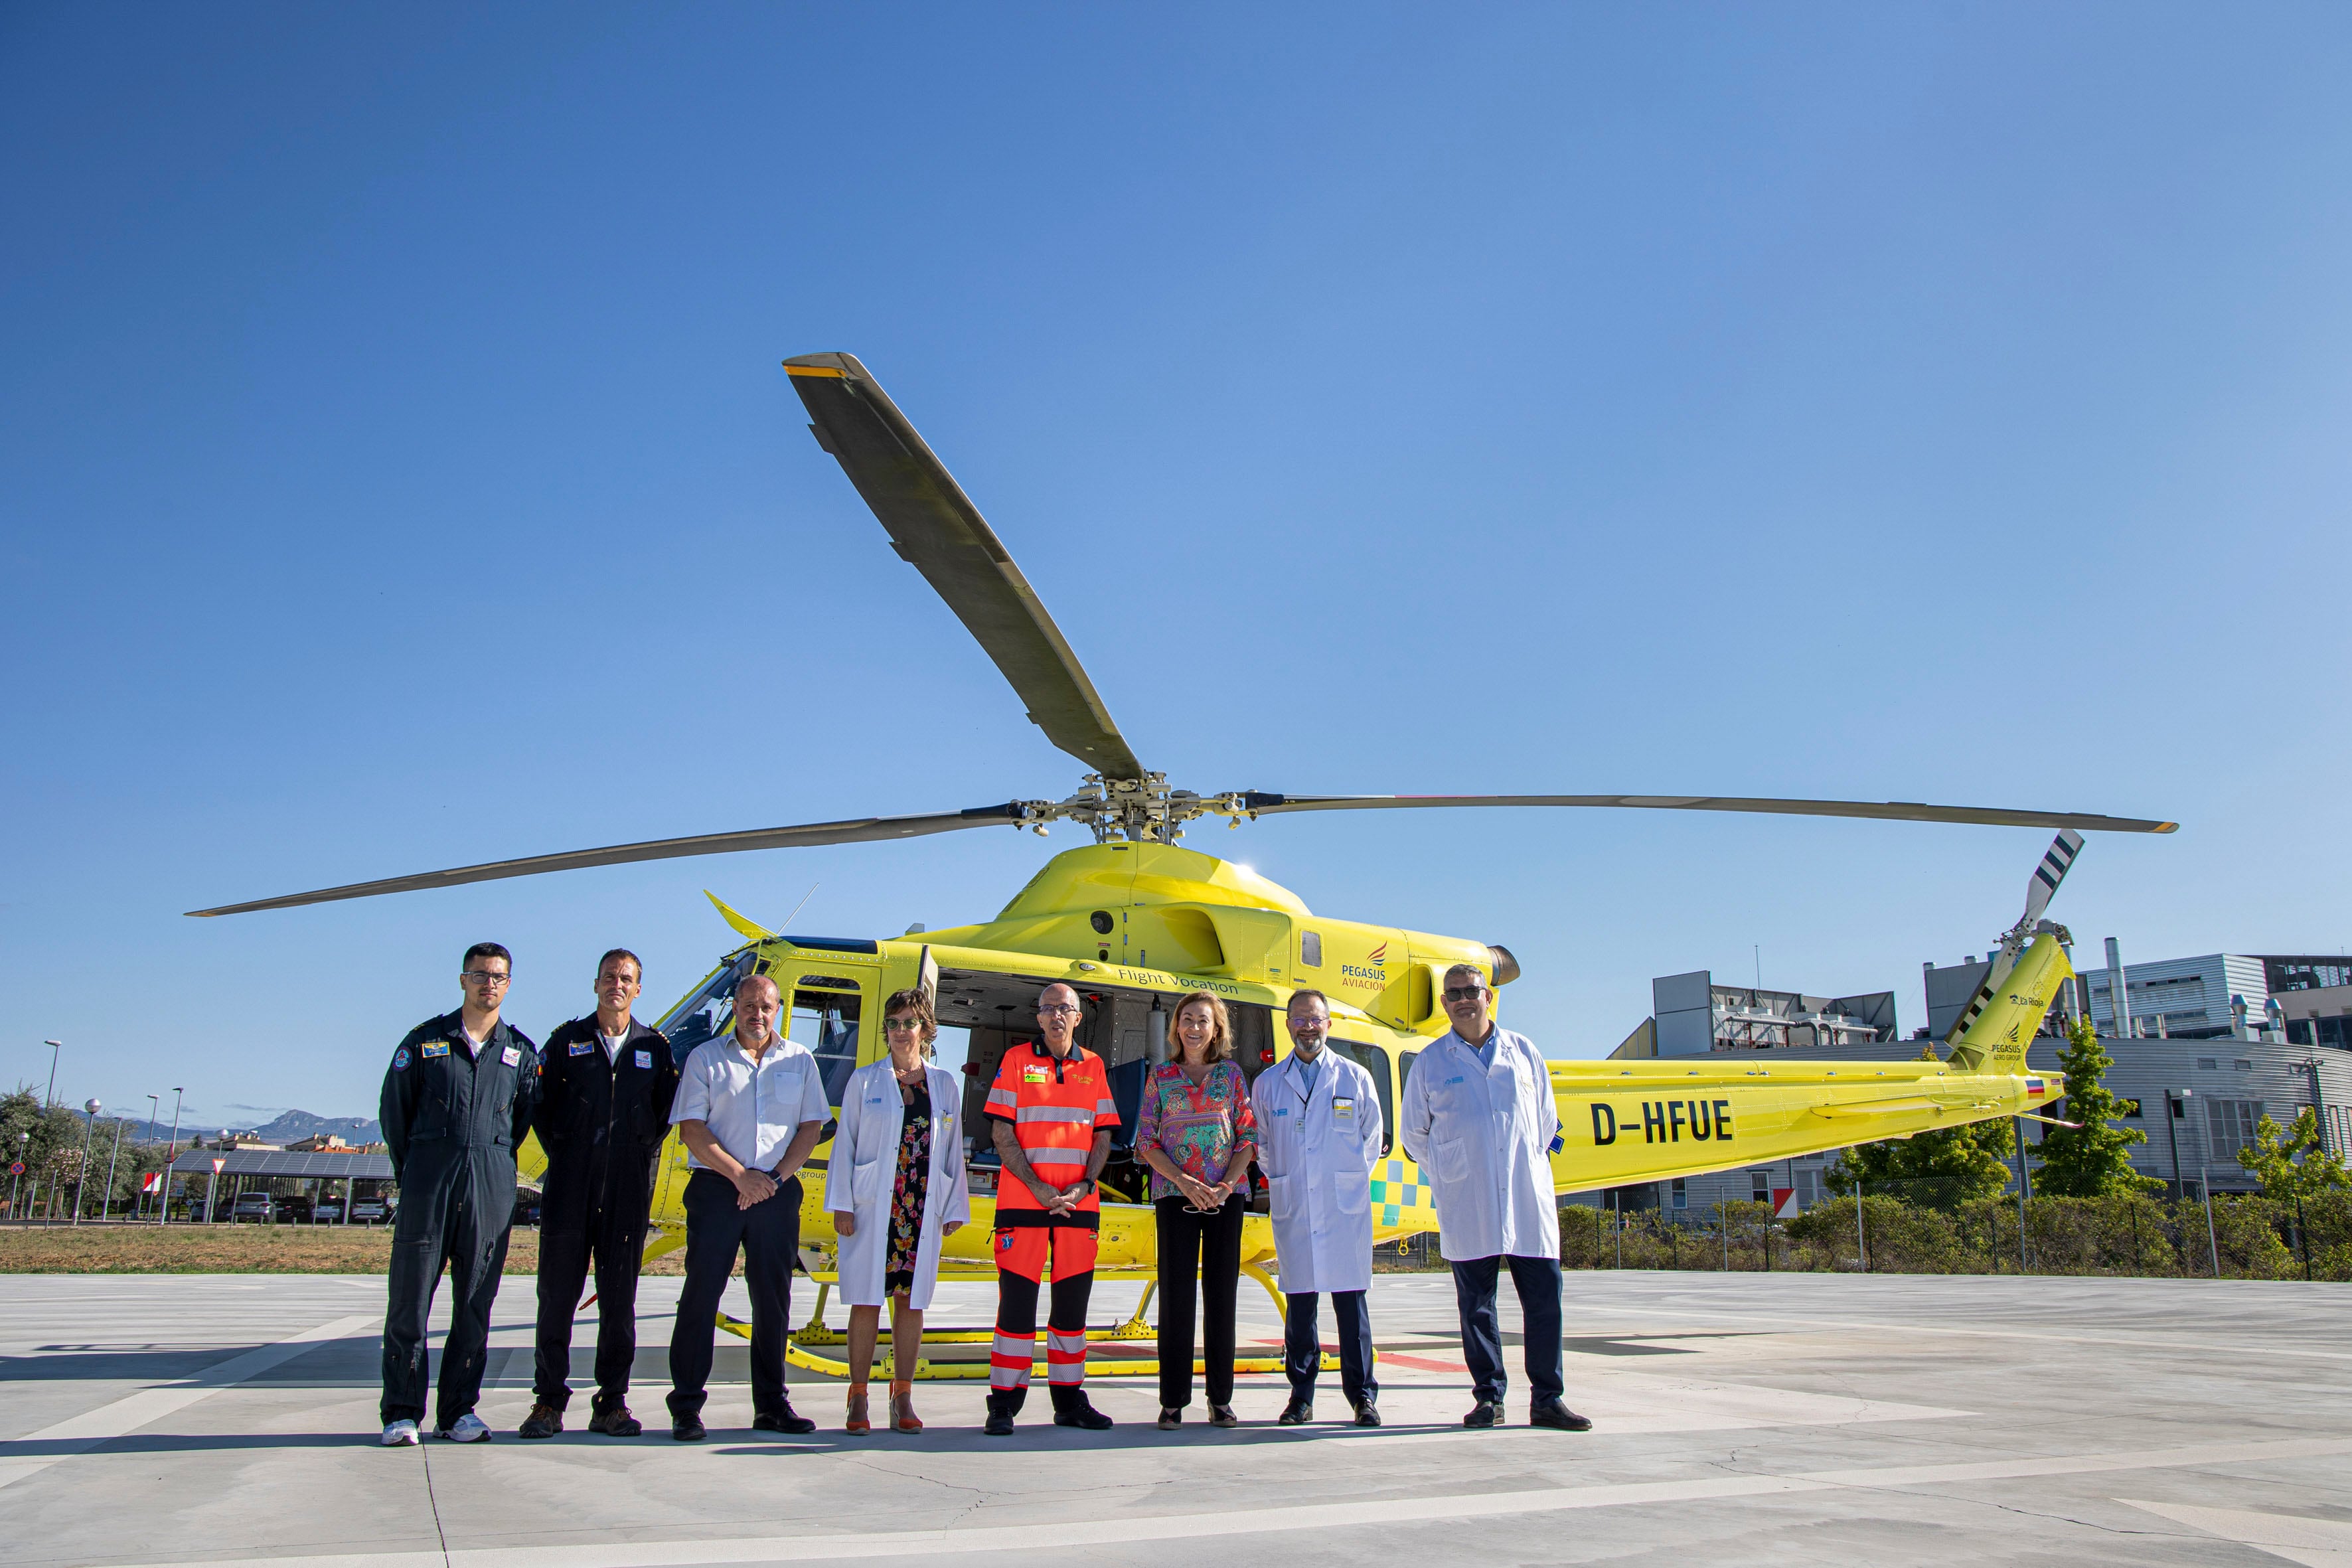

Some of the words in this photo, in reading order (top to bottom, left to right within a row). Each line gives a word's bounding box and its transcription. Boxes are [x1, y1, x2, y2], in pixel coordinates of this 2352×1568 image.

[1342, 965, 1385, 980] PEGASUS
[1118, 969, 1166, 984] Flight
[1168, 975, 1239, 994] Vocation
[1342, 977, 1385, 992] AVIACIÓN
[2019, 996, 2028, 1005] La
[2028, 997, 2044, 1008] Rioja
[1992, 1044, 2021, 1054] PEGASUS
[1590, 1099, 1733, 1146] D-HFUE
